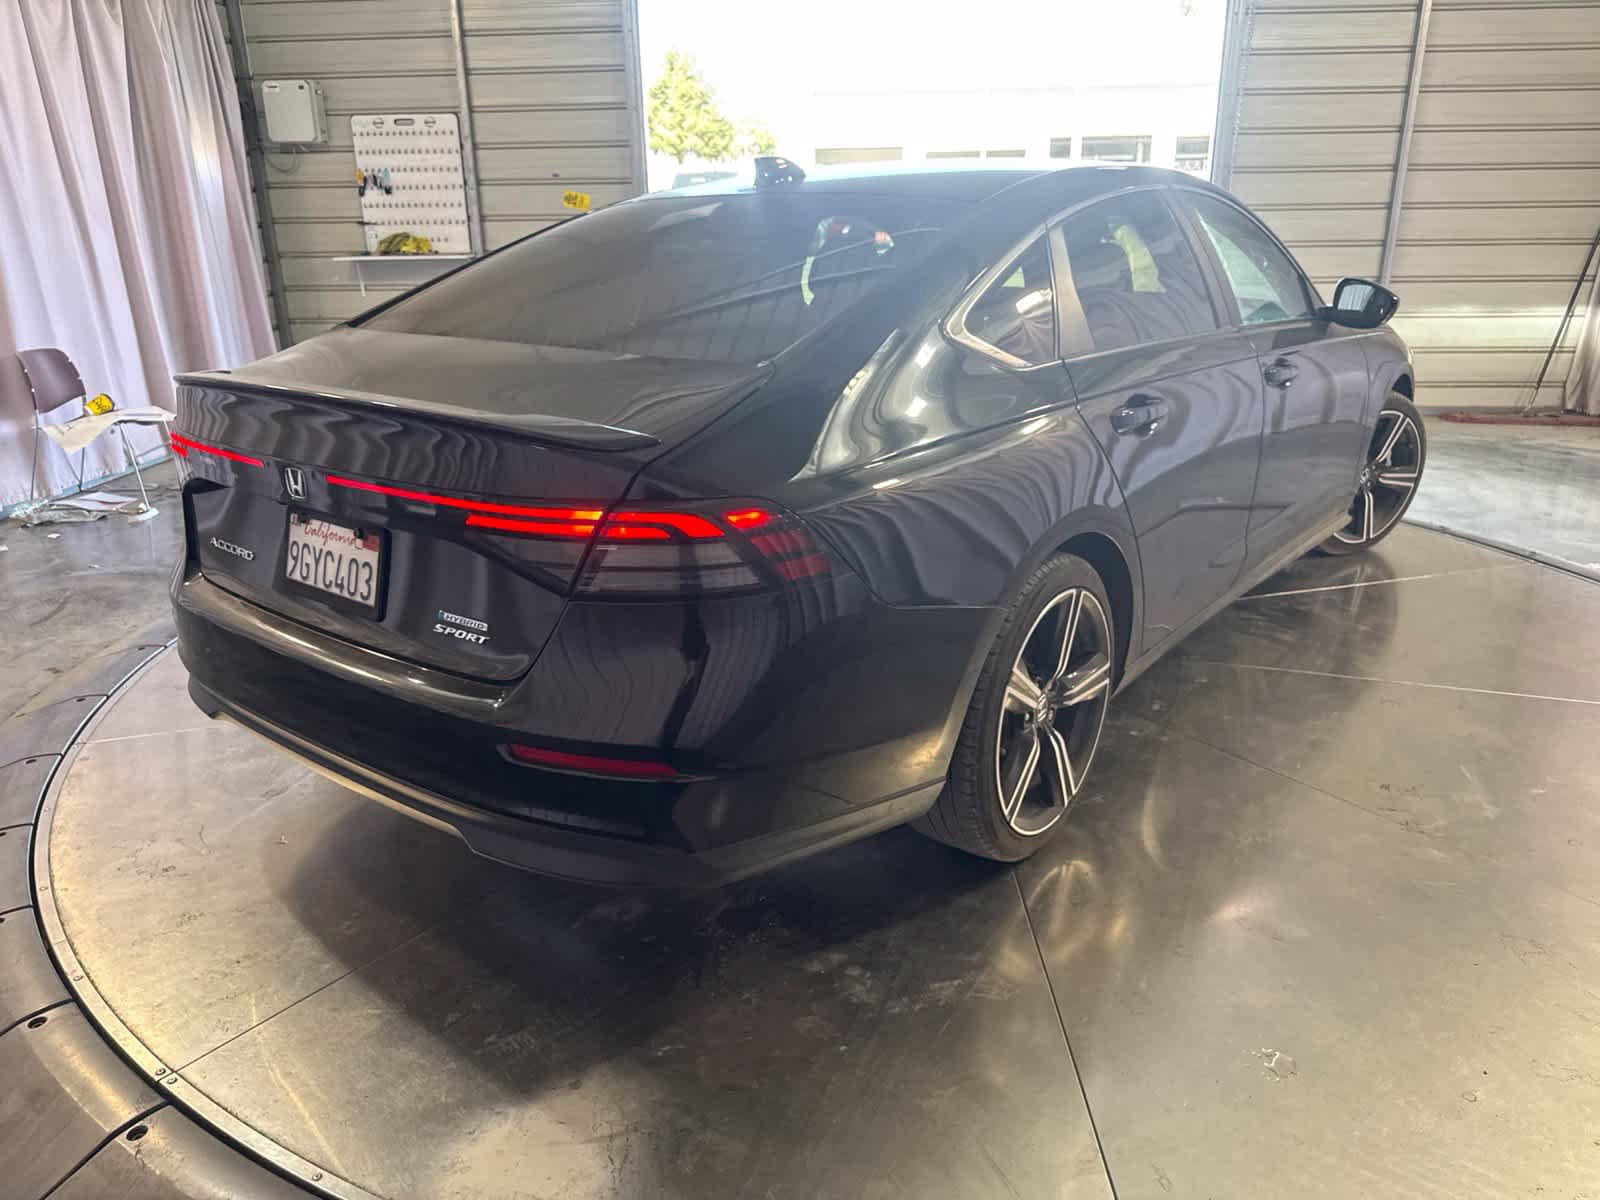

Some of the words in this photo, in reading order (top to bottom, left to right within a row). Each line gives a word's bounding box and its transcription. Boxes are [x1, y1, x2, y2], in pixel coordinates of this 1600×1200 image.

[302, 519, 357, 546] California
[210, 537, 254, 561] ACCORD
[288, 540, 373, 601] 9GYC403
[433, 623, 491, 644] SPORT
